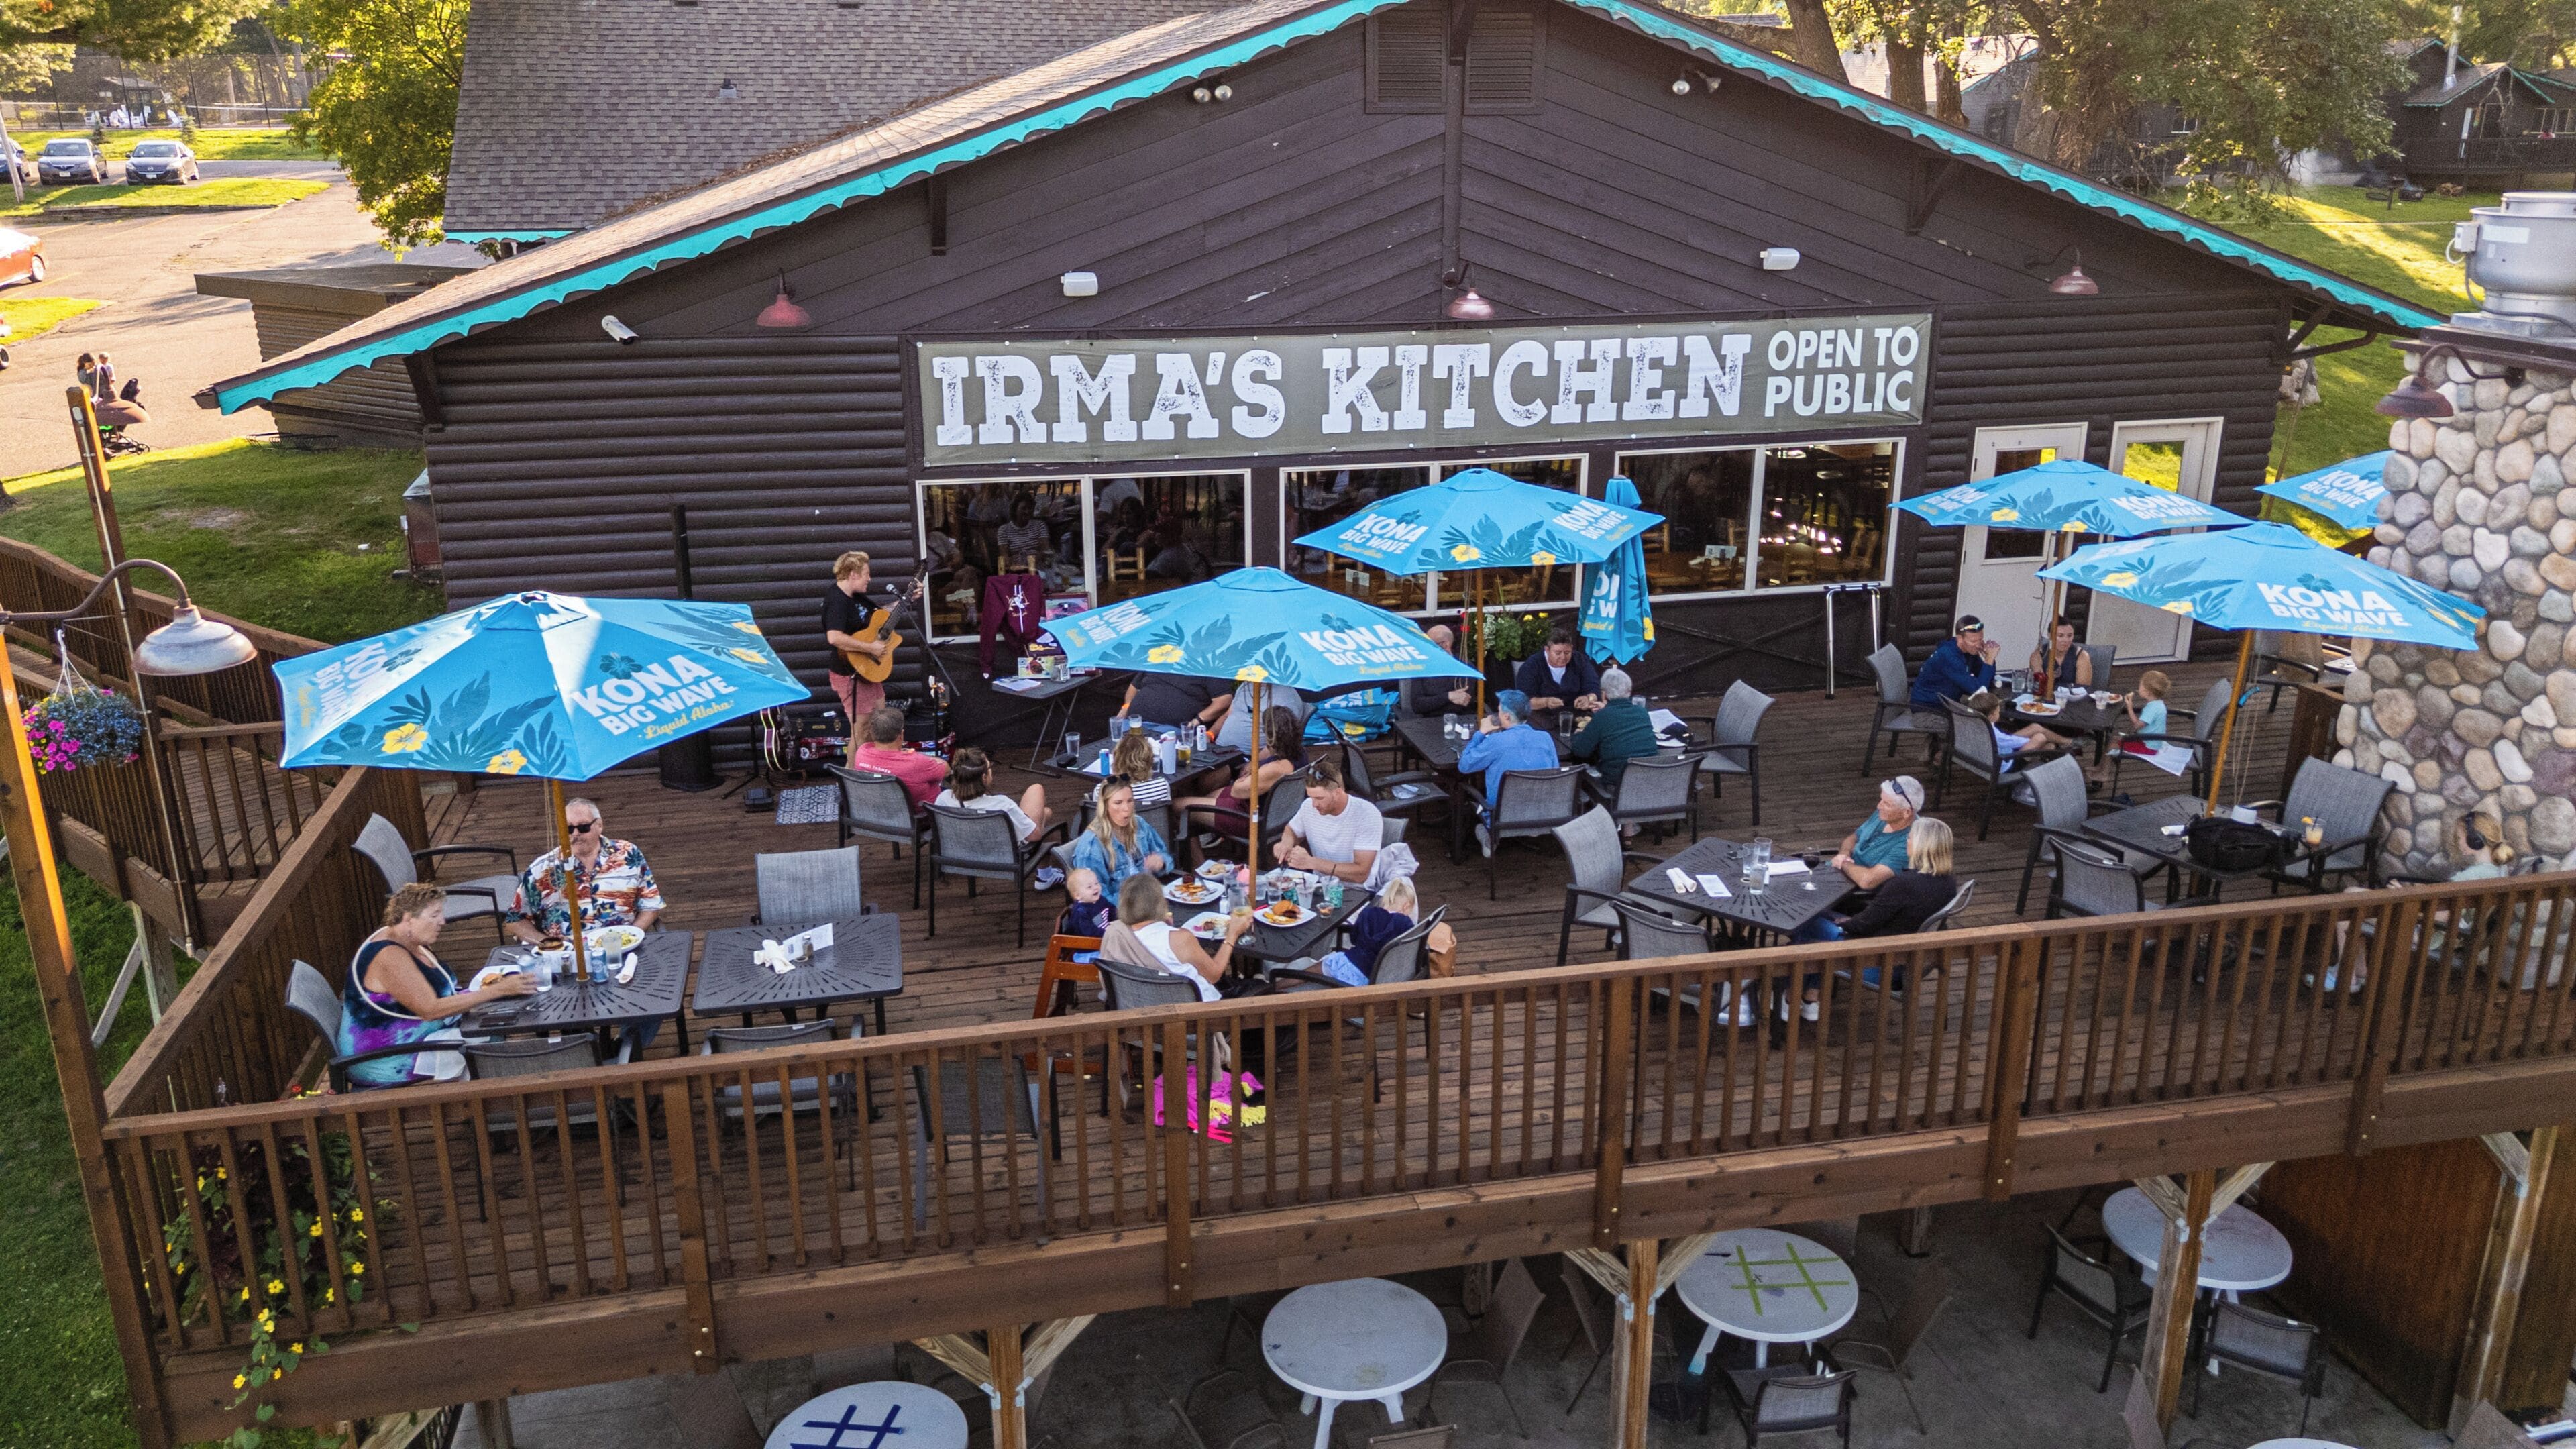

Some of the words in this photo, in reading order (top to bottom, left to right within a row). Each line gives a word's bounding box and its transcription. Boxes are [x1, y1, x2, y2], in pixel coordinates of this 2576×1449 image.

[1768, 329, 1862, 371] OPEN
[1874, 325, 1919, 366] TO
[932, 349, 1285, 445] IRMA'S
[1322, 334, 1752, 433] KITCHEN
[1764, 370, 1913, 417] PUBLIC
[2299, 480, 2330, 495] BIG
[2324, 488, 2367, 508] WAVE
[2318, 470, 2385, 500] KONA
[1552, 500, 1609, 531] KONA
[2110, 495, 2196, 511] KONA
[2131, 508, 2167, 519] BIG
[2160, 506, 2213, 517] WAVE
[1354, 513, 1428, 542] KONA
[1593, 511, 1628, 530] WAVE
[1338, 529, 1371, 543] BIG
[1366, 536, 1411, 554] WAVE
[2257, 582, 2397, 612] KONA
[2269, 604, 2320, 620] BIG
[2320, 608, 2413, 627] WAVE
[1299, 625, 1409, 652] KONA
[1323, 651, 1366, 665] BIG
[1359, 646, 1429, 663] WAVE
[570, 654, 714, 718] KONA
[599, 705, 657, 735] BIG
[647, 676, 739, 714] WAVE
[643, 714, 690, 739] Liquid
[691, 702, 731, 720] Aloha
